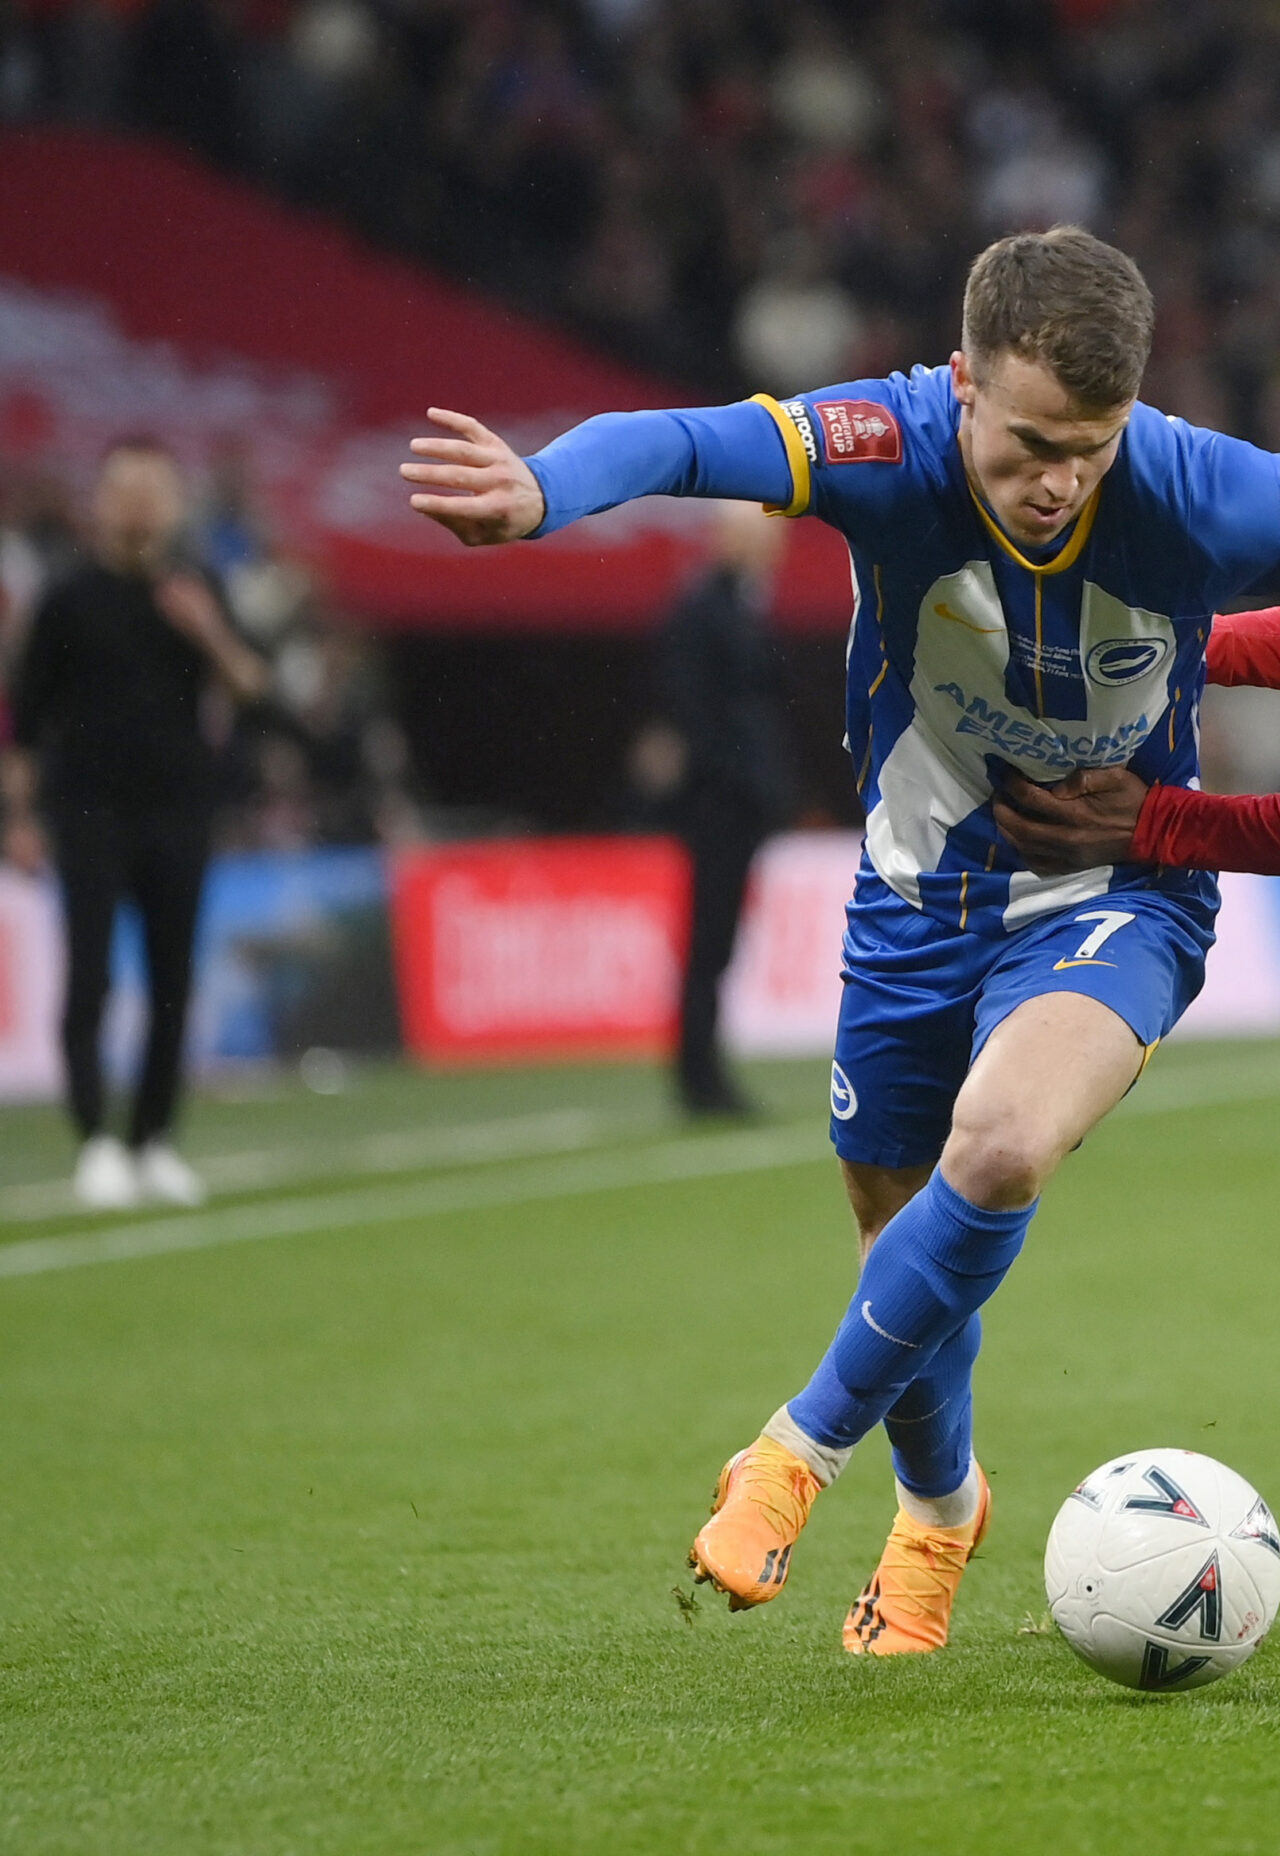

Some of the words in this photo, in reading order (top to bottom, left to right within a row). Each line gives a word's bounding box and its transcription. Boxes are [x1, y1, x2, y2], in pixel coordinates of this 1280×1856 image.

[823, 407, 838, 422] FA
[835, 406, 855, 452] Emirates
[830, 423, 846, 454] CUP
[1073, 909, 1137, 959] 7
